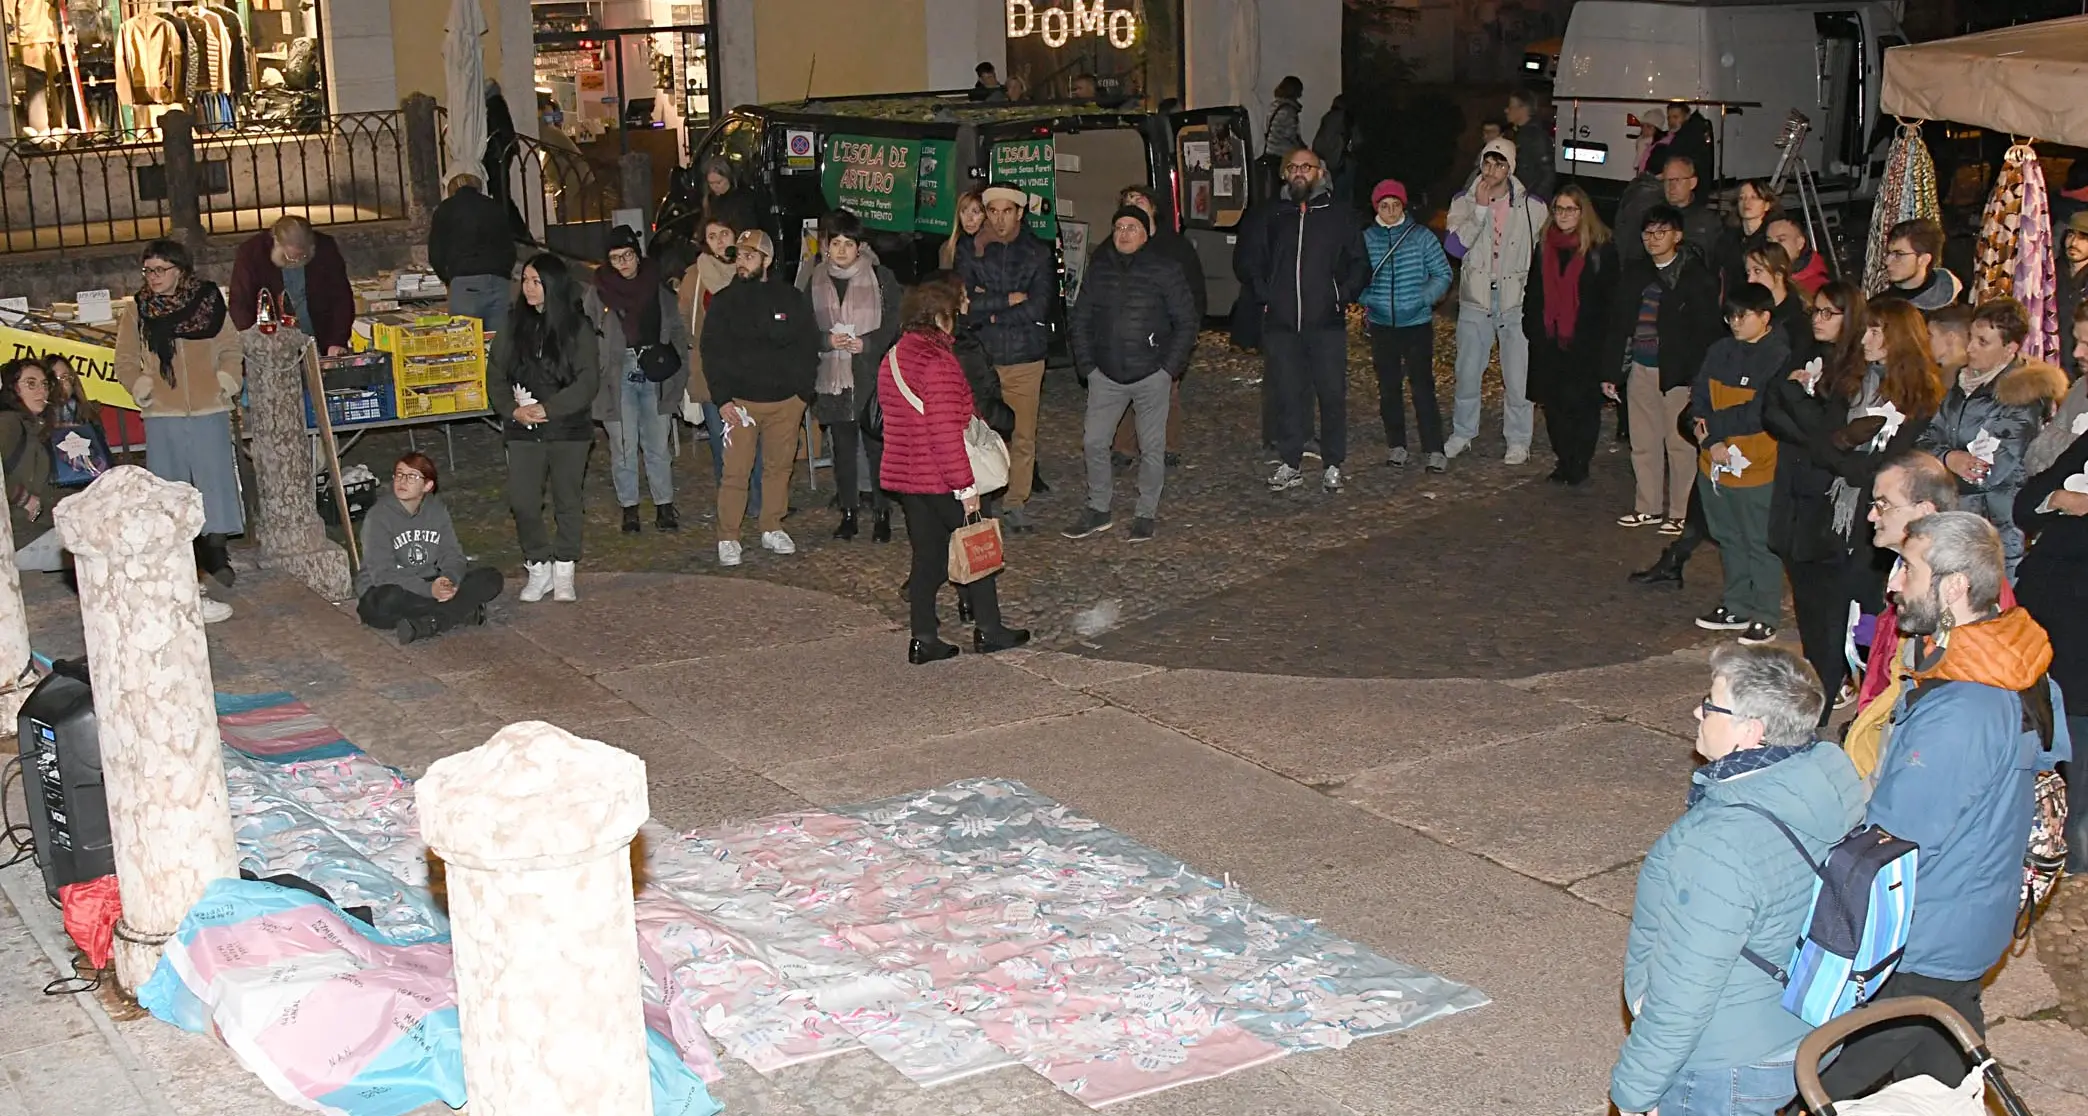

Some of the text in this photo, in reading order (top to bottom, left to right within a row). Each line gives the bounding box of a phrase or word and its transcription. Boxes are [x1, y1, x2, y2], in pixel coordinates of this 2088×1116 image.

[832, 140, 885, 167] L'ISOLA
[888, 146, 909, 168] DI
[997, 146, 1041, 164] L'ISOLA
[839, 168, 895, 195] ARTURO
